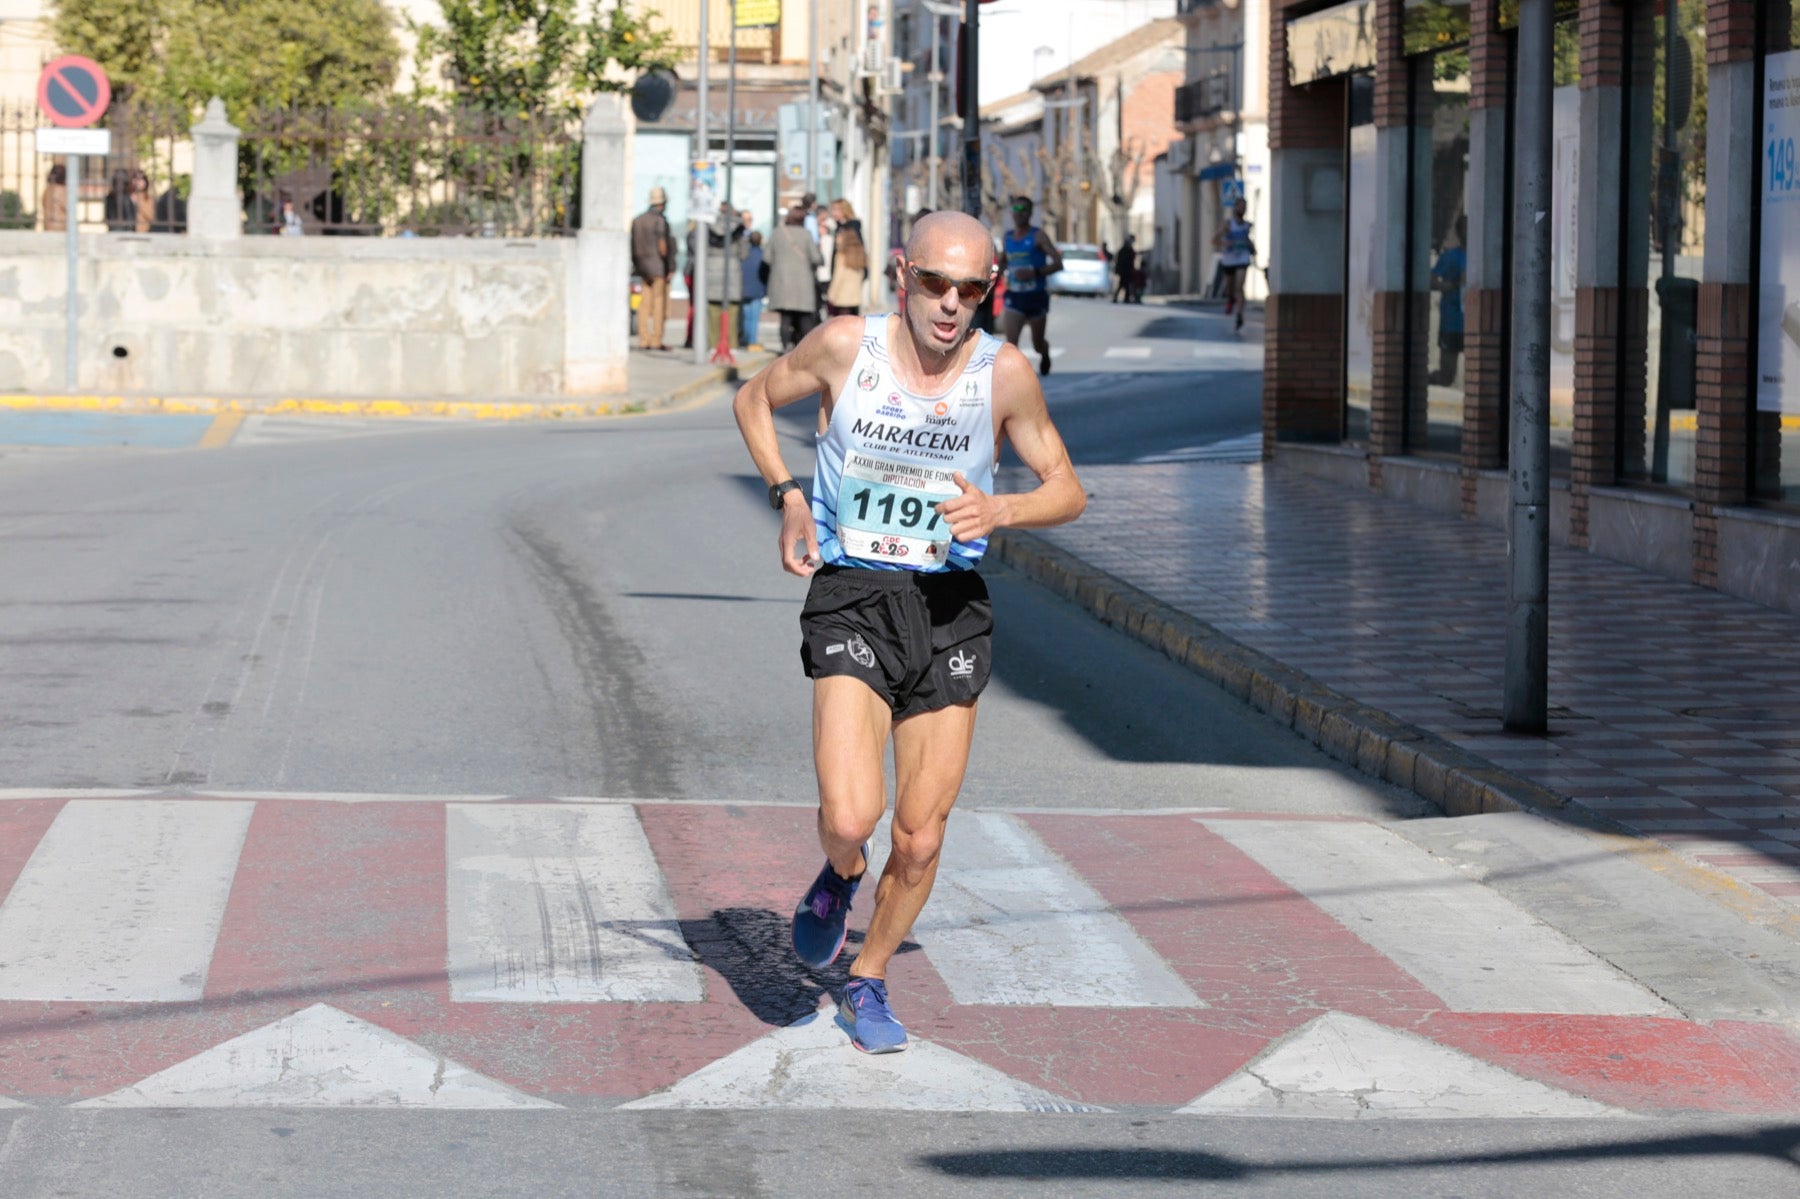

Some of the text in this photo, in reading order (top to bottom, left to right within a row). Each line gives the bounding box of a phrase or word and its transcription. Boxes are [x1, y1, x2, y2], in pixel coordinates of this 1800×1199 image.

[1768, 136, 1795, 192] 149
[851, 418, 970, 452] MARACENA
[863, 442, 887, 450] CLUB
[903, 448, 954, 461] ATLETISMO
[874, 460, 894, 472] GRAN
[896, 464, 923, 477] PREMIO
[924, 470, 933, 480] DE
[853, 487, 943, 531] 1197
